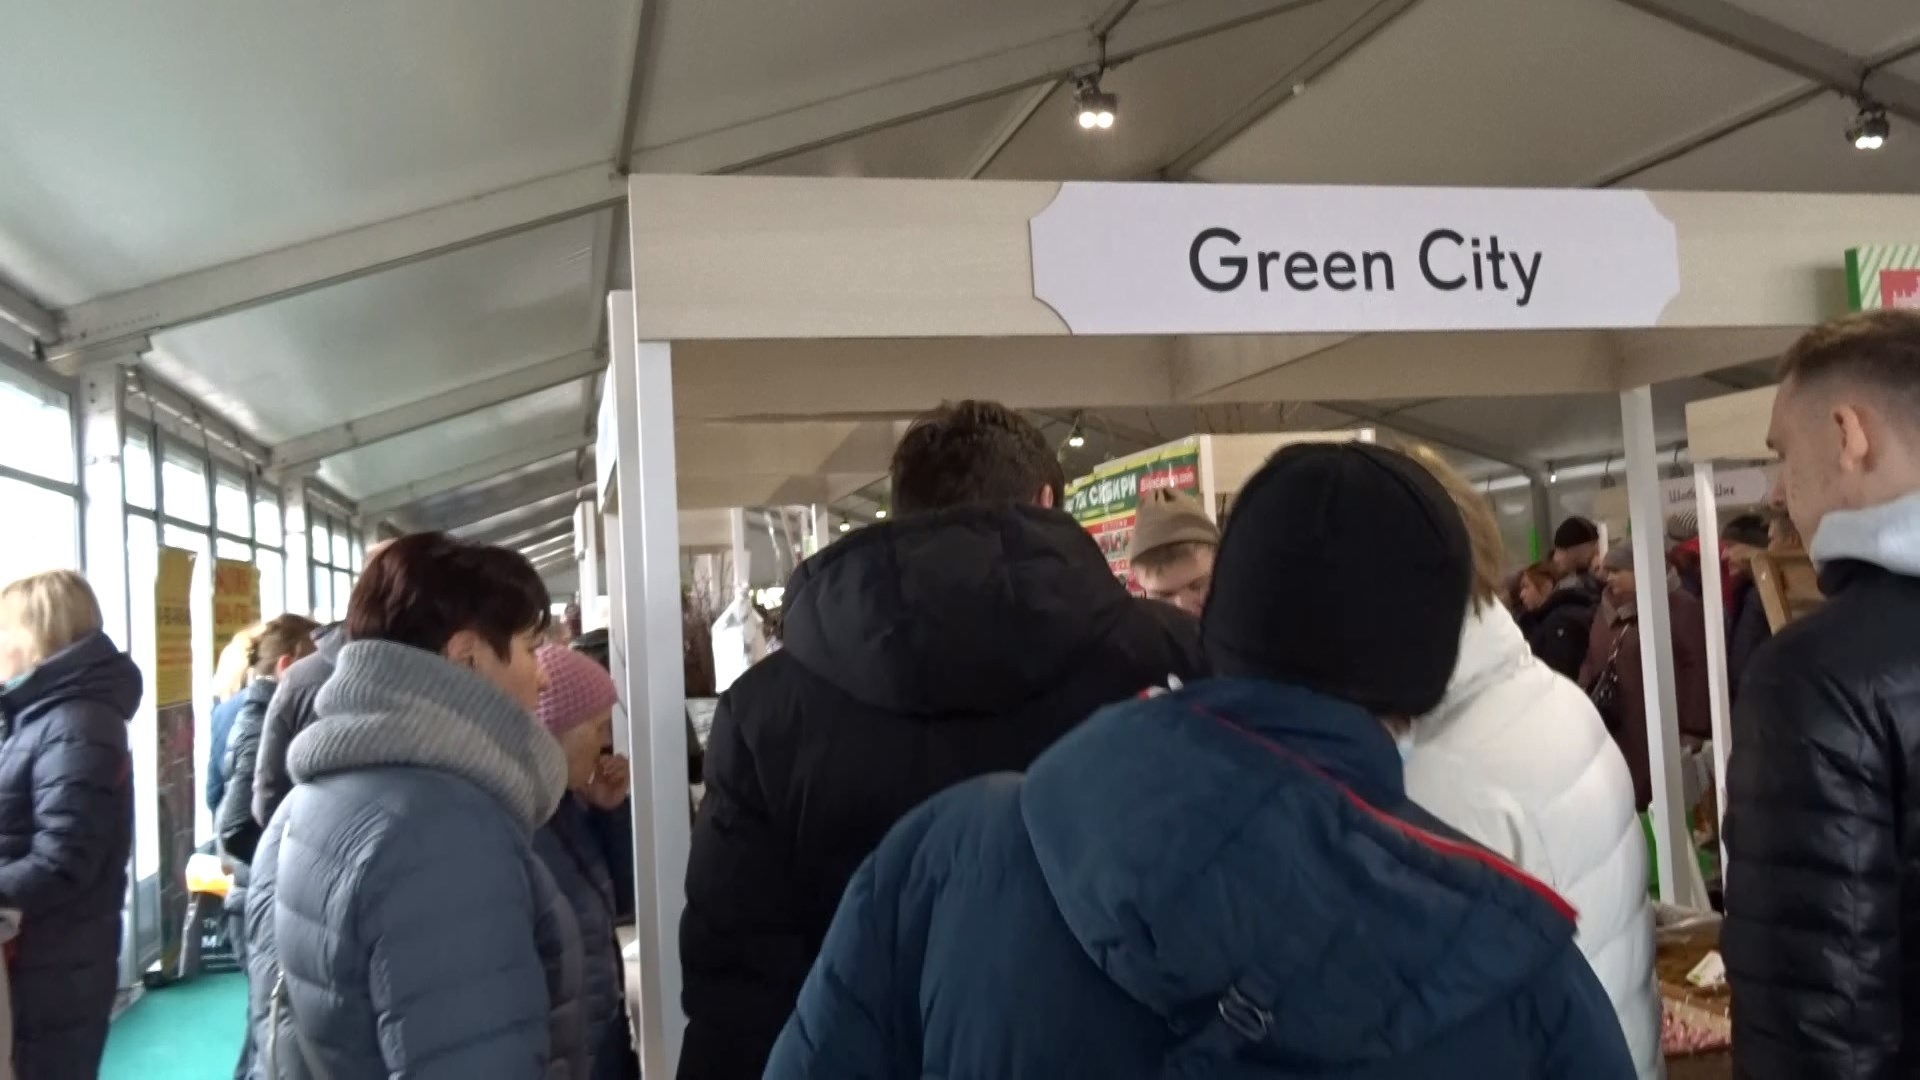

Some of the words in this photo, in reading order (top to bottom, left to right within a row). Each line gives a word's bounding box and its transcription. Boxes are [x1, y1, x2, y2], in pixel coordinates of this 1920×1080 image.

[1189, 227, 1394, 292] Green
[1418, 228, 1542, 307] City
[1089, 473, 1137, 505] СИБИРИ
